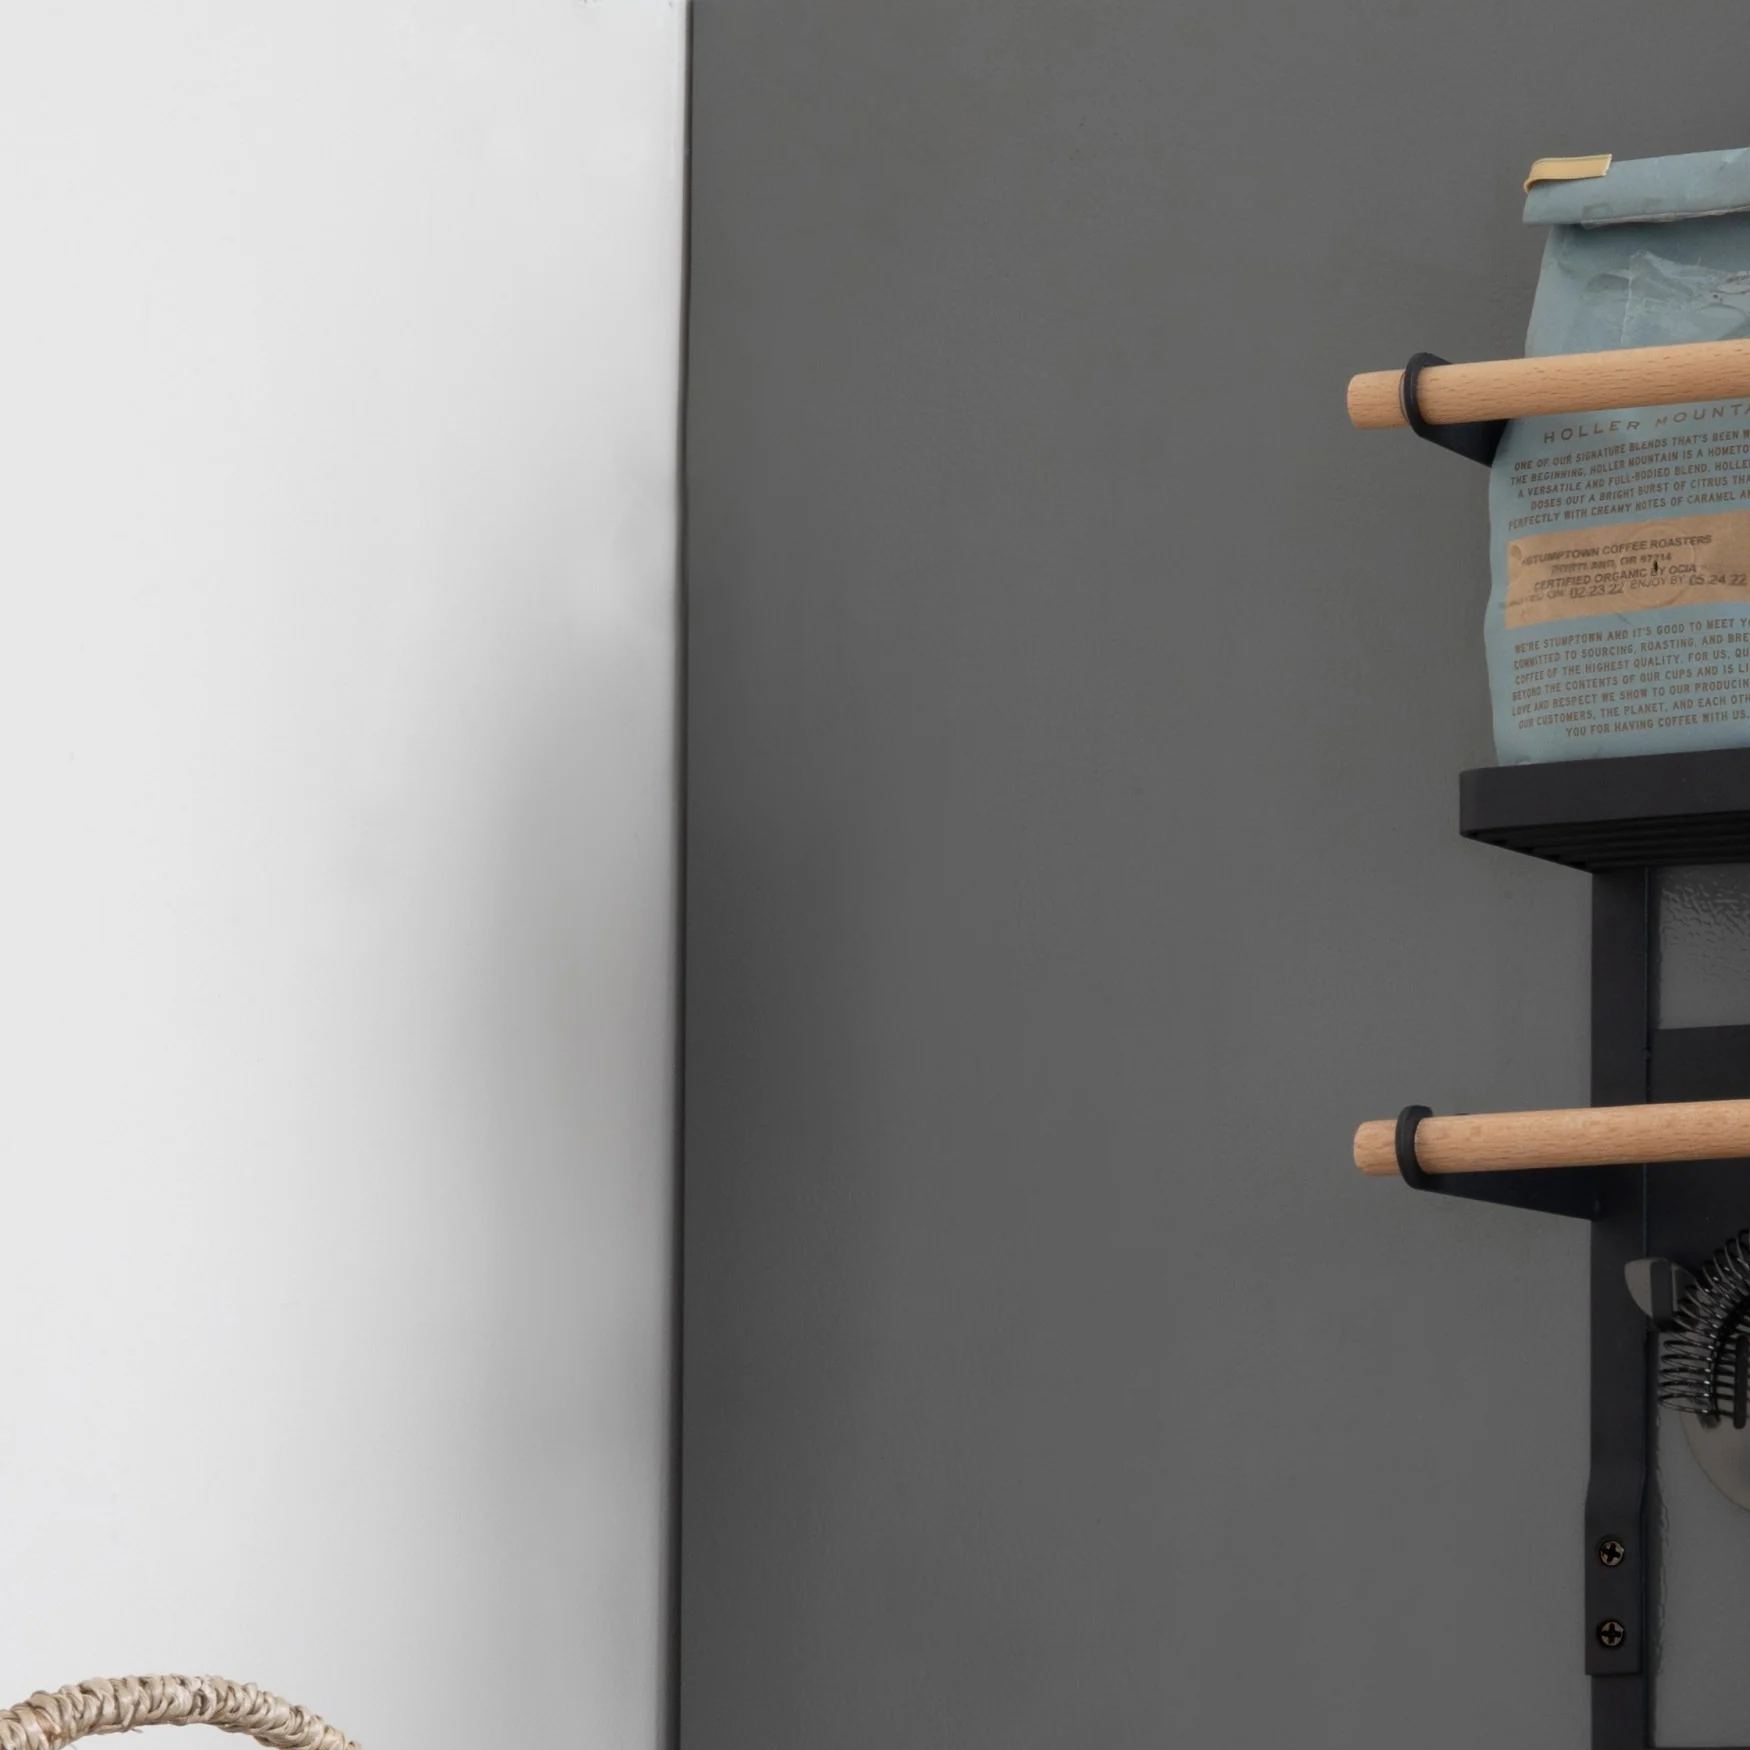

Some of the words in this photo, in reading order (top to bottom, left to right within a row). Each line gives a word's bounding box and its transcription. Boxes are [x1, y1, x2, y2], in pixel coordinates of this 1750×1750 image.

[1544, 420, 1640, 444] HOLLER
[1511, 474, 1527, 486] THE
[1590, 460, 1625, 475] HOLLER
[1628, 451, 1679, 467] MOUNTAIN
[1683, 449, 1692, 459] IS
[1697, 448, 1703, 458] A
[1514, 460, 1532, 472] ONE
[1537, 458, 1550, 468] OF
[1553, 454, 1573, 467] OUR
[1576, 444, 1626, 463] SIGNATURE
[1629, 437, 1668, 452] BLENDS
[1672, 434, 1708, 447] THAT'S
[1712, 430, 1739, 442] BEEN
[1528, 481, 1582, 496] VERSATILE
[1585, 478, 1605, 490] AND
[1608, 467, 1670, 487] FULL-BODIED
[1531, 500, 1562, 511] DOSES
[1566, 495, 1585, 506] OUT
[1588, 494, 1595, 502] A
[1600, 488, 1635, 502] BRIGHT
[1638, 482, 1669, 495] BURST
[1673, 480, 1687, 491] OF
[1690, 476, 1728, 489] CITRUS
[1508, 513, 1559, 531] PERFECTLY
[1564, 508, 1588, 520] WITH
[1591, 503, 1632, 516] CREAMY
[1635, 497, 1666, 510] NOTES
[1670, 496, 1683, 507] OF
[1686, 491, 1735, 504] CARAMEL
[1525, 549, 1600, 566] STUMPTOWN
[1602, 540, 1647, 555] COFFEE
[1650, 534, 1713, 549] ROASTERS
[1620, 556, 1637, 566] OR
[1534, 575, 1591, 592] CERTIFIED
[1595, 568, 1647, 583] ORGANIC
[1630, 576, 1666, 590] ENJOY
[1543, 632, 1602, 648] STUMPTOWN
[1607, 630, 1628, 640] AND
[1632, 626, 1652, 638] IT'S
[1656, 624, 1685, 635] GOOD
[1689, 621, 1702, 632] TO
[1706, 618, 1735, 630] MEET
[1513, 652, 1561, 670] COMMITTED
[1565, 650, 1577, 661] TO
[1701, 634, 1723, 645] AND
[1515, 670, 1545, 685] COFFEE
[1547, 667, 1558, 679] OF
[1562, 664, 1581, 676] THE
[1585, 659, 1629, 674] HIGHEST
[1688, 651, 1708, 662] FOR
[1512, 686, 1542, 701] BEYOND
[1545, 682, 1561, 694] THE
[1565, 676, 1618, 691] CONTENTS
[1622, 674, 1636, 684] OF
[1639, 671, 1660, 682] OUR
[1664, 668, 1693, 680] CUPS
[1696, 666, 1718, 677] AND
[1723, 664, 1734, 674] IS
[1512, 704, 1531, 717] LOVE
[1534, 700, 1549, 712] AND
[1552, 694, 1597, 708] RESPECT
[1601, 692, 1615, 703] WE
[1619, 688, 1648, 700] SHOW
[1652, 686, 1665, 697] TO
[1669, 684, 1690, 695] OUR
[1518, 718, 1534, 730] OUR
[1600, 705, 1620, 718] THE
[1672, 699, 1694, 711] AND
[1697, 696, 1727, 708] EACH
[1566, 726, 1586, 738] YOU
[1590, 723, 1610, 735] FOR
[1614, 719, 1654, 733] HAVING
[1658, 714, 1698, 727] COFFEE
[1702, 711, 1729, 723] WITH
